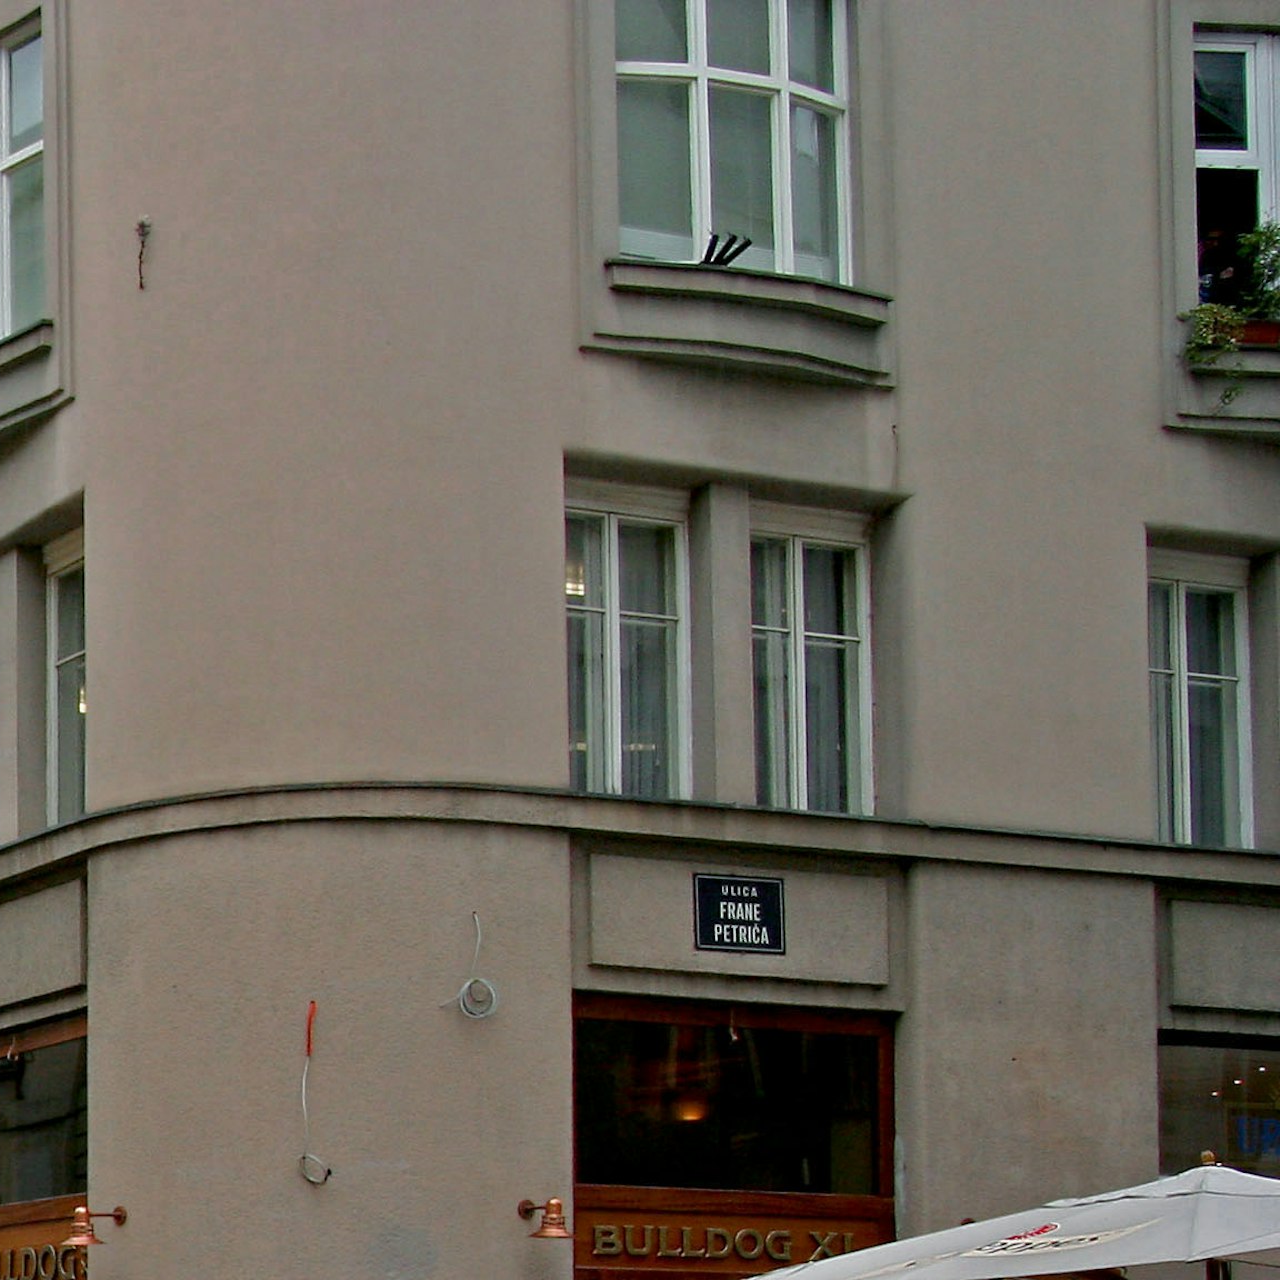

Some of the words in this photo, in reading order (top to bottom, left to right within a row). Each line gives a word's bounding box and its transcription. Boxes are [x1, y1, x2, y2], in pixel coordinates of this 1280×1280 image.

[721, 884, 758, 898] ULICA
[719, 901, 761, 922] FRANE
[592, 1224, 791, 1261] BULLDOG
